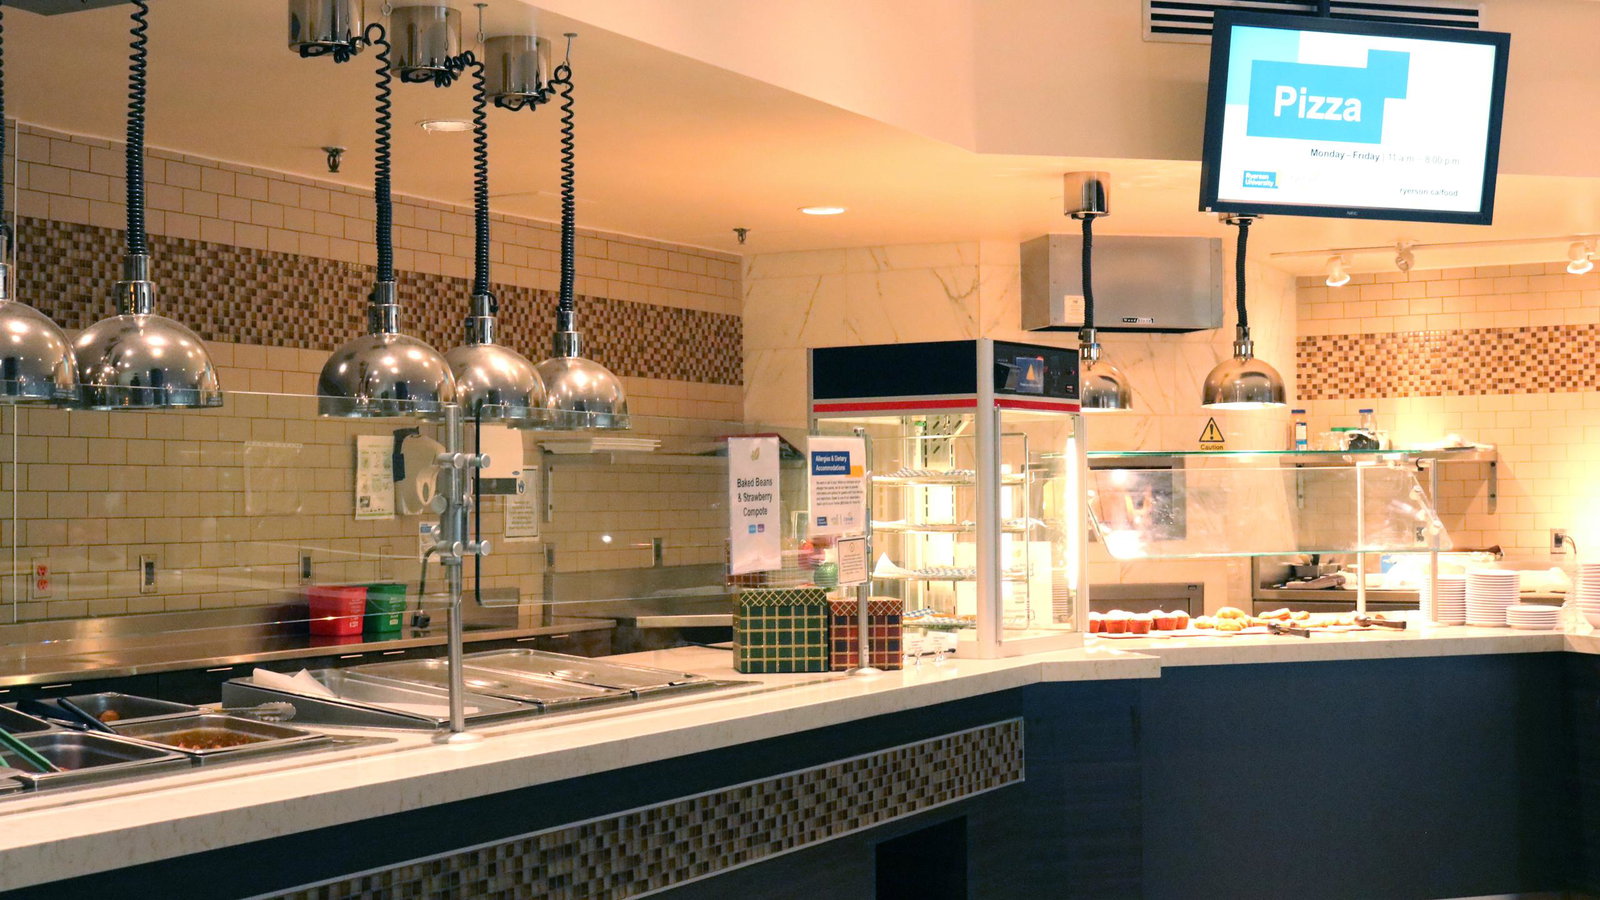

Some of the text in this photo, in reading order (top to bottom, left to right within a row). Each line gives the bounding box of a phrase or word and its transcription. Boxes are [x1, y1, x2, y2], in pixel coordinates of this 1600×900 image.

[1274, 85, 1361, 122] Pizza
[1311, 148, 1345, 160] Monday
[1353, 151, 1381, 162] Friday
[737, 477, 772, 487] Baked Beans
[738, 492, 772, 503] & Strawberry
[743, 507, 768, 518] Compote
